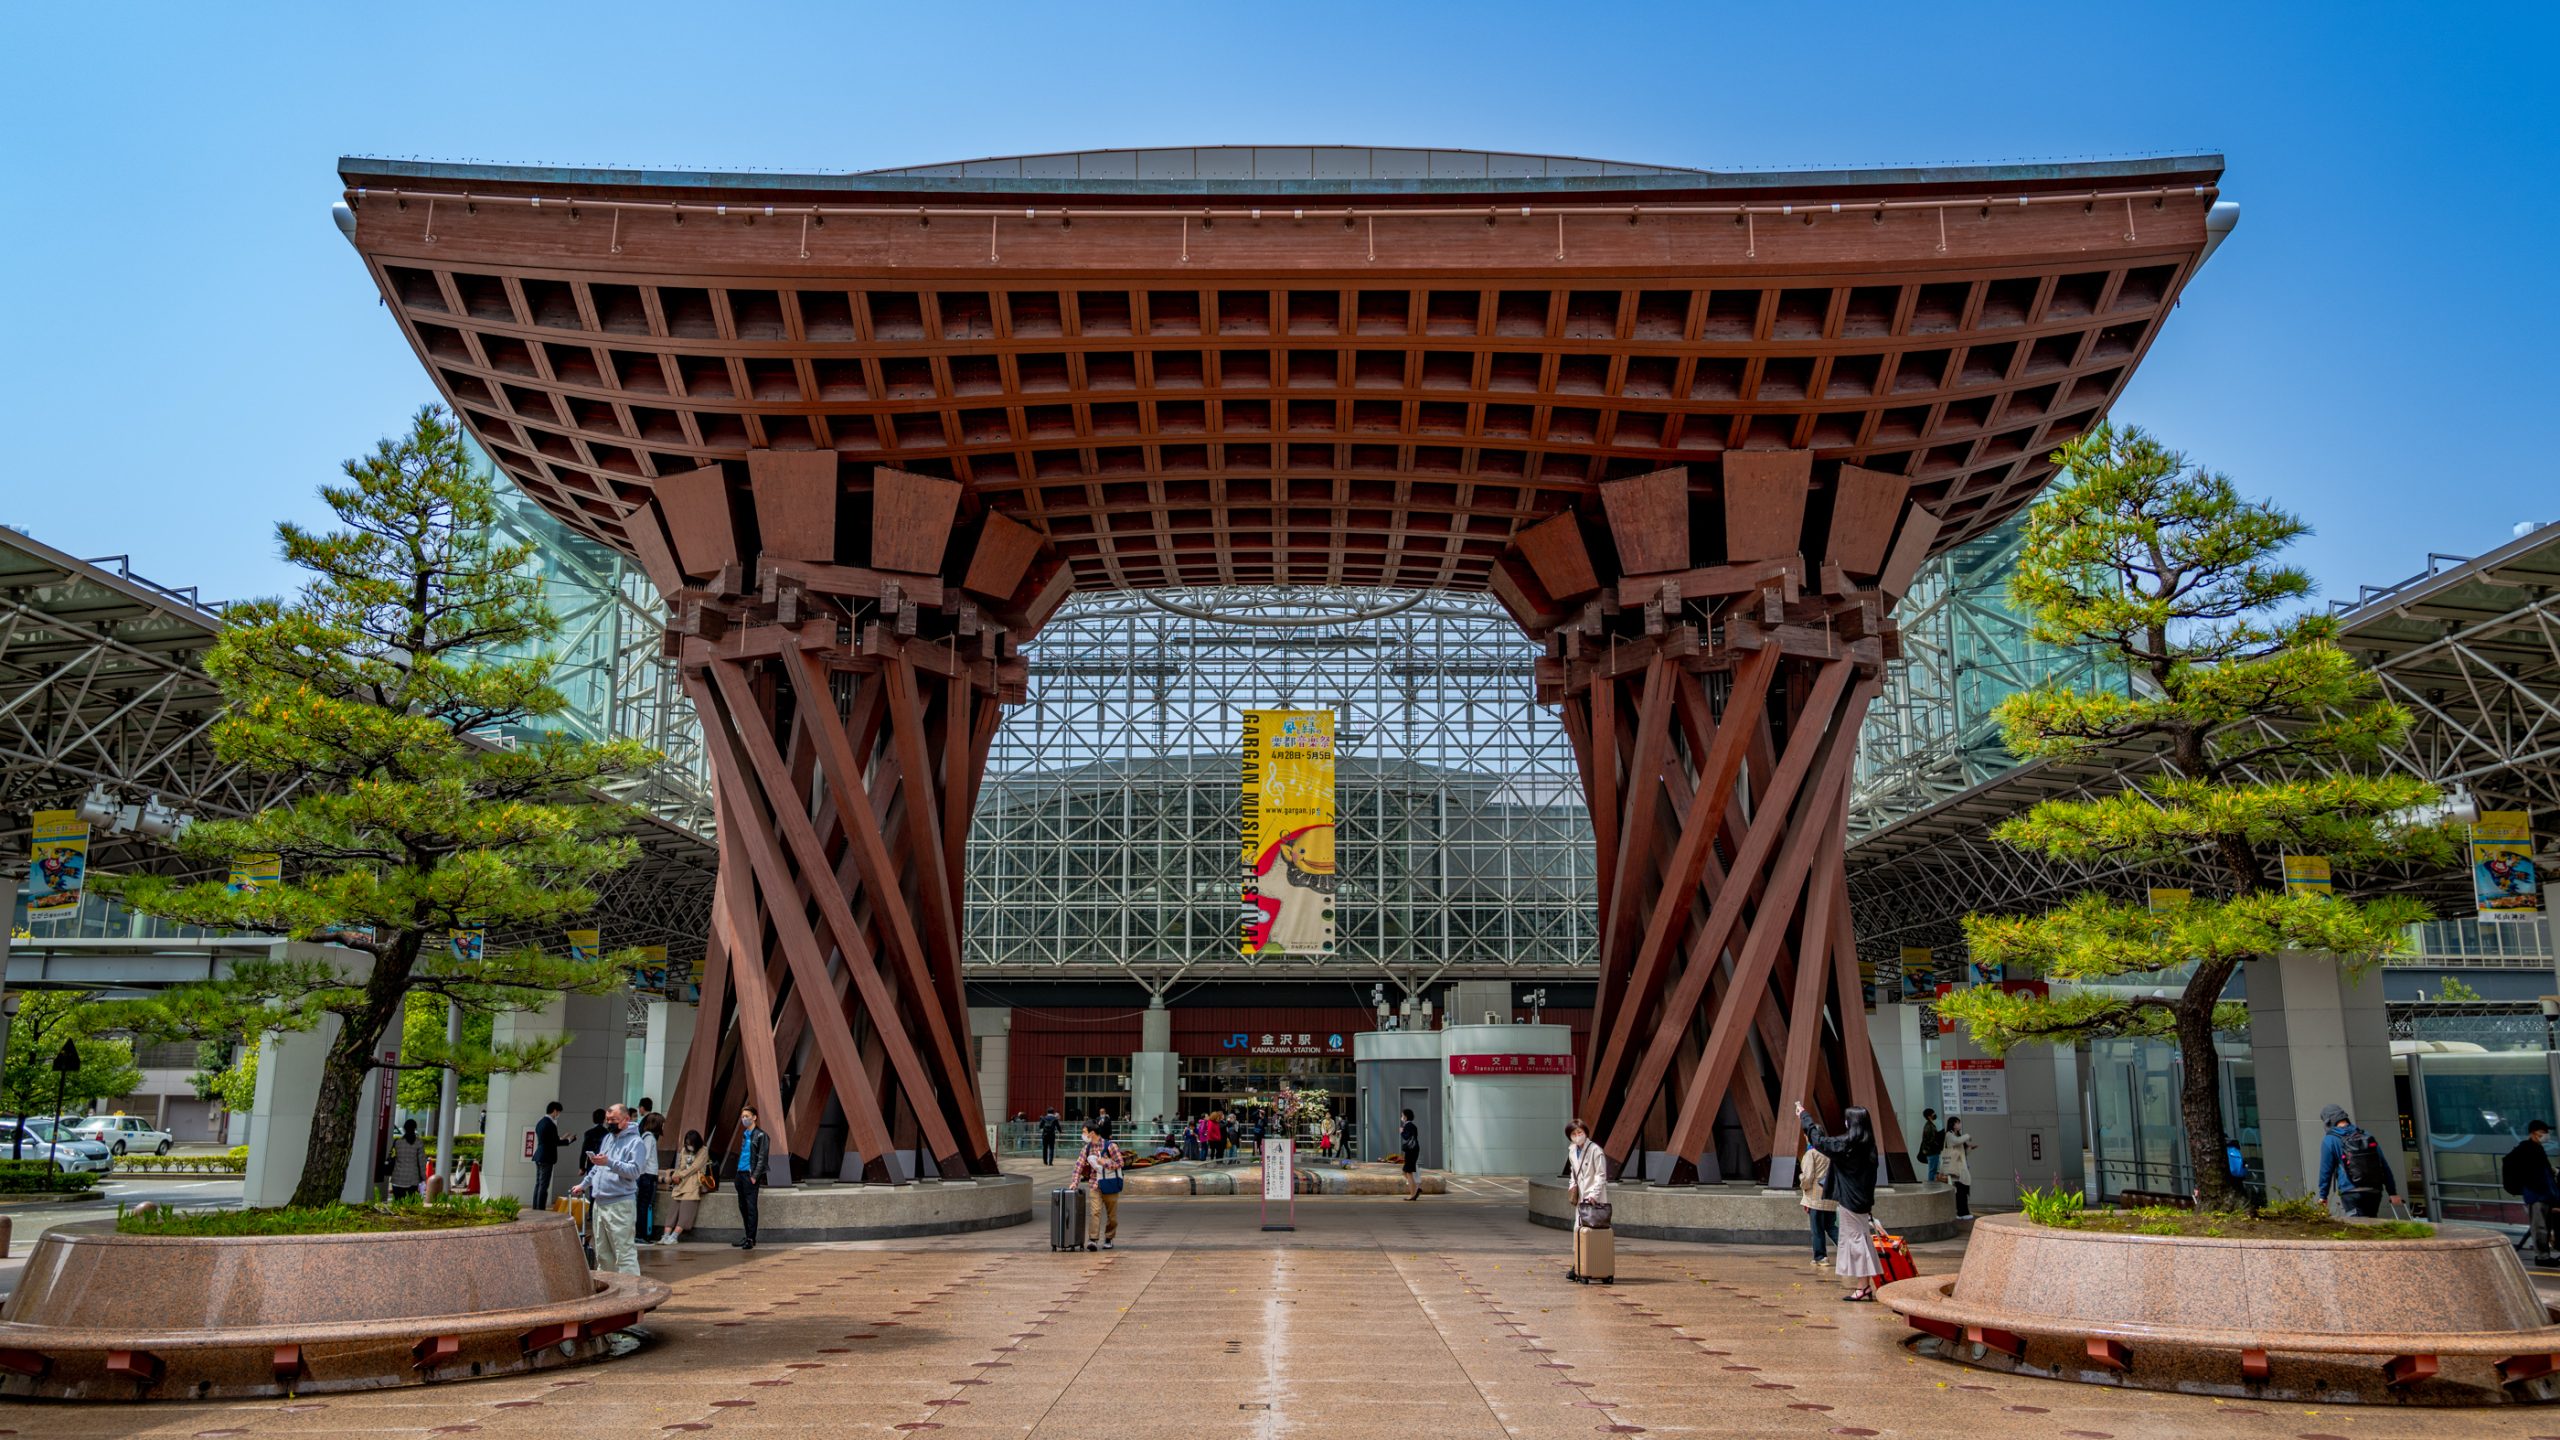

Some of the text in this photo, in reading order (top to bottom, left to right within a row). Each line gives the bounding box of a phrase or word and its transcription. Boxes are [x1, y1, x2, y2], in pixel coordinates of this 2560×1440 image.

[1265, 806, 1316, 816] www.gargan.jp
[1240, 714, 1259, 949] GARGAN MUSIC FESTIVAL
[1223, 1034, 1249, 1049] JR
[1261, 1034, 1311, 1045] 金沢駅
[1474, 1065, 1522, 1073] Transportation
